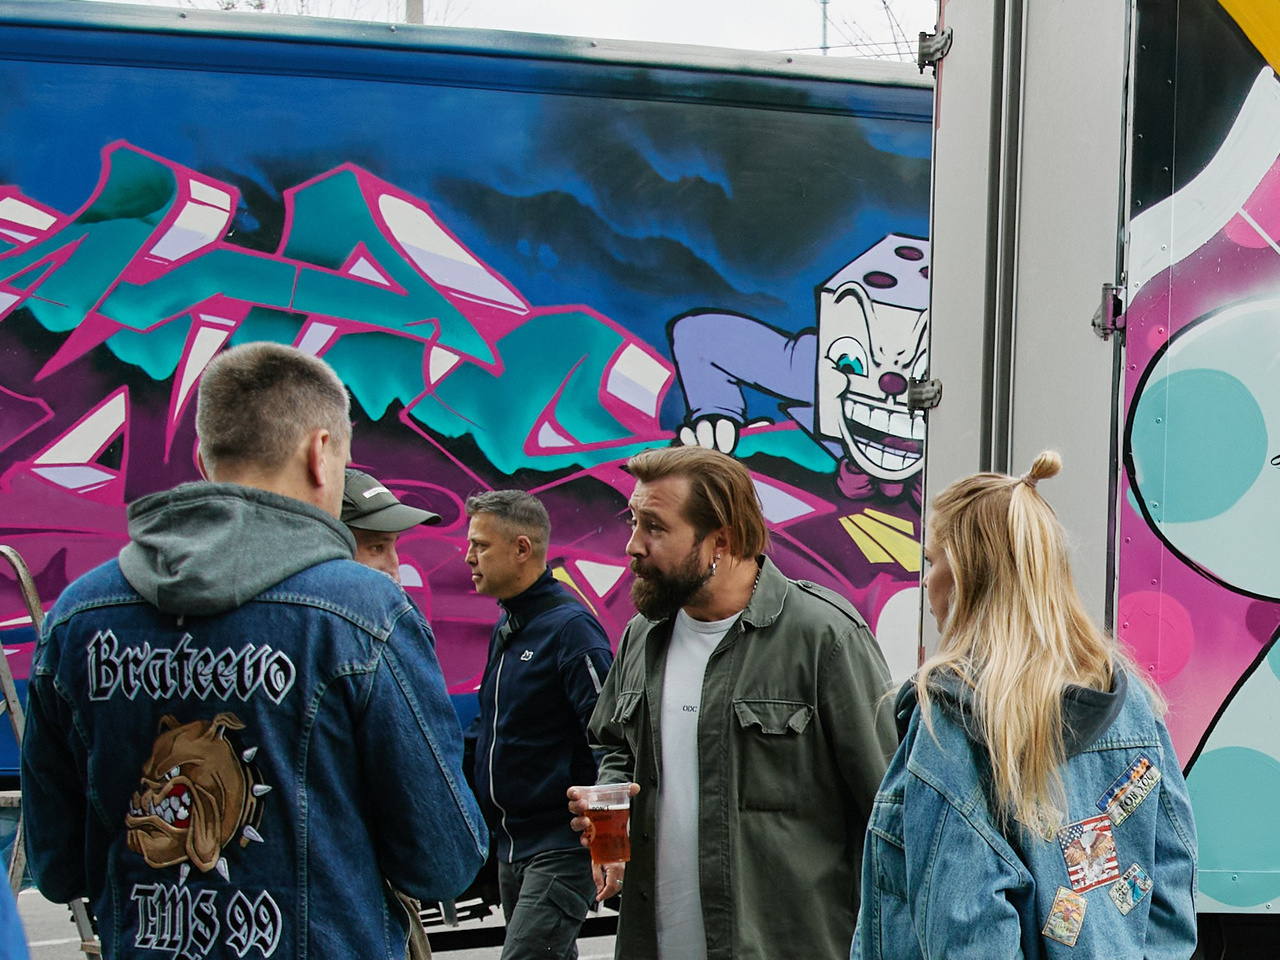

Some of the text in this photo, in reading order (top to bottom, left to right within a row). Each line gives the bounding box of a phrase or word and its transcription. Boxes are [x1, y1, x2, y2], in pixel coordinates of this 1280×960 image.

[87, 628, 297, 705] Brateevo
[1119, 772, 1155, 812] FOR YOU
[225, 889, 283, 959] 99
